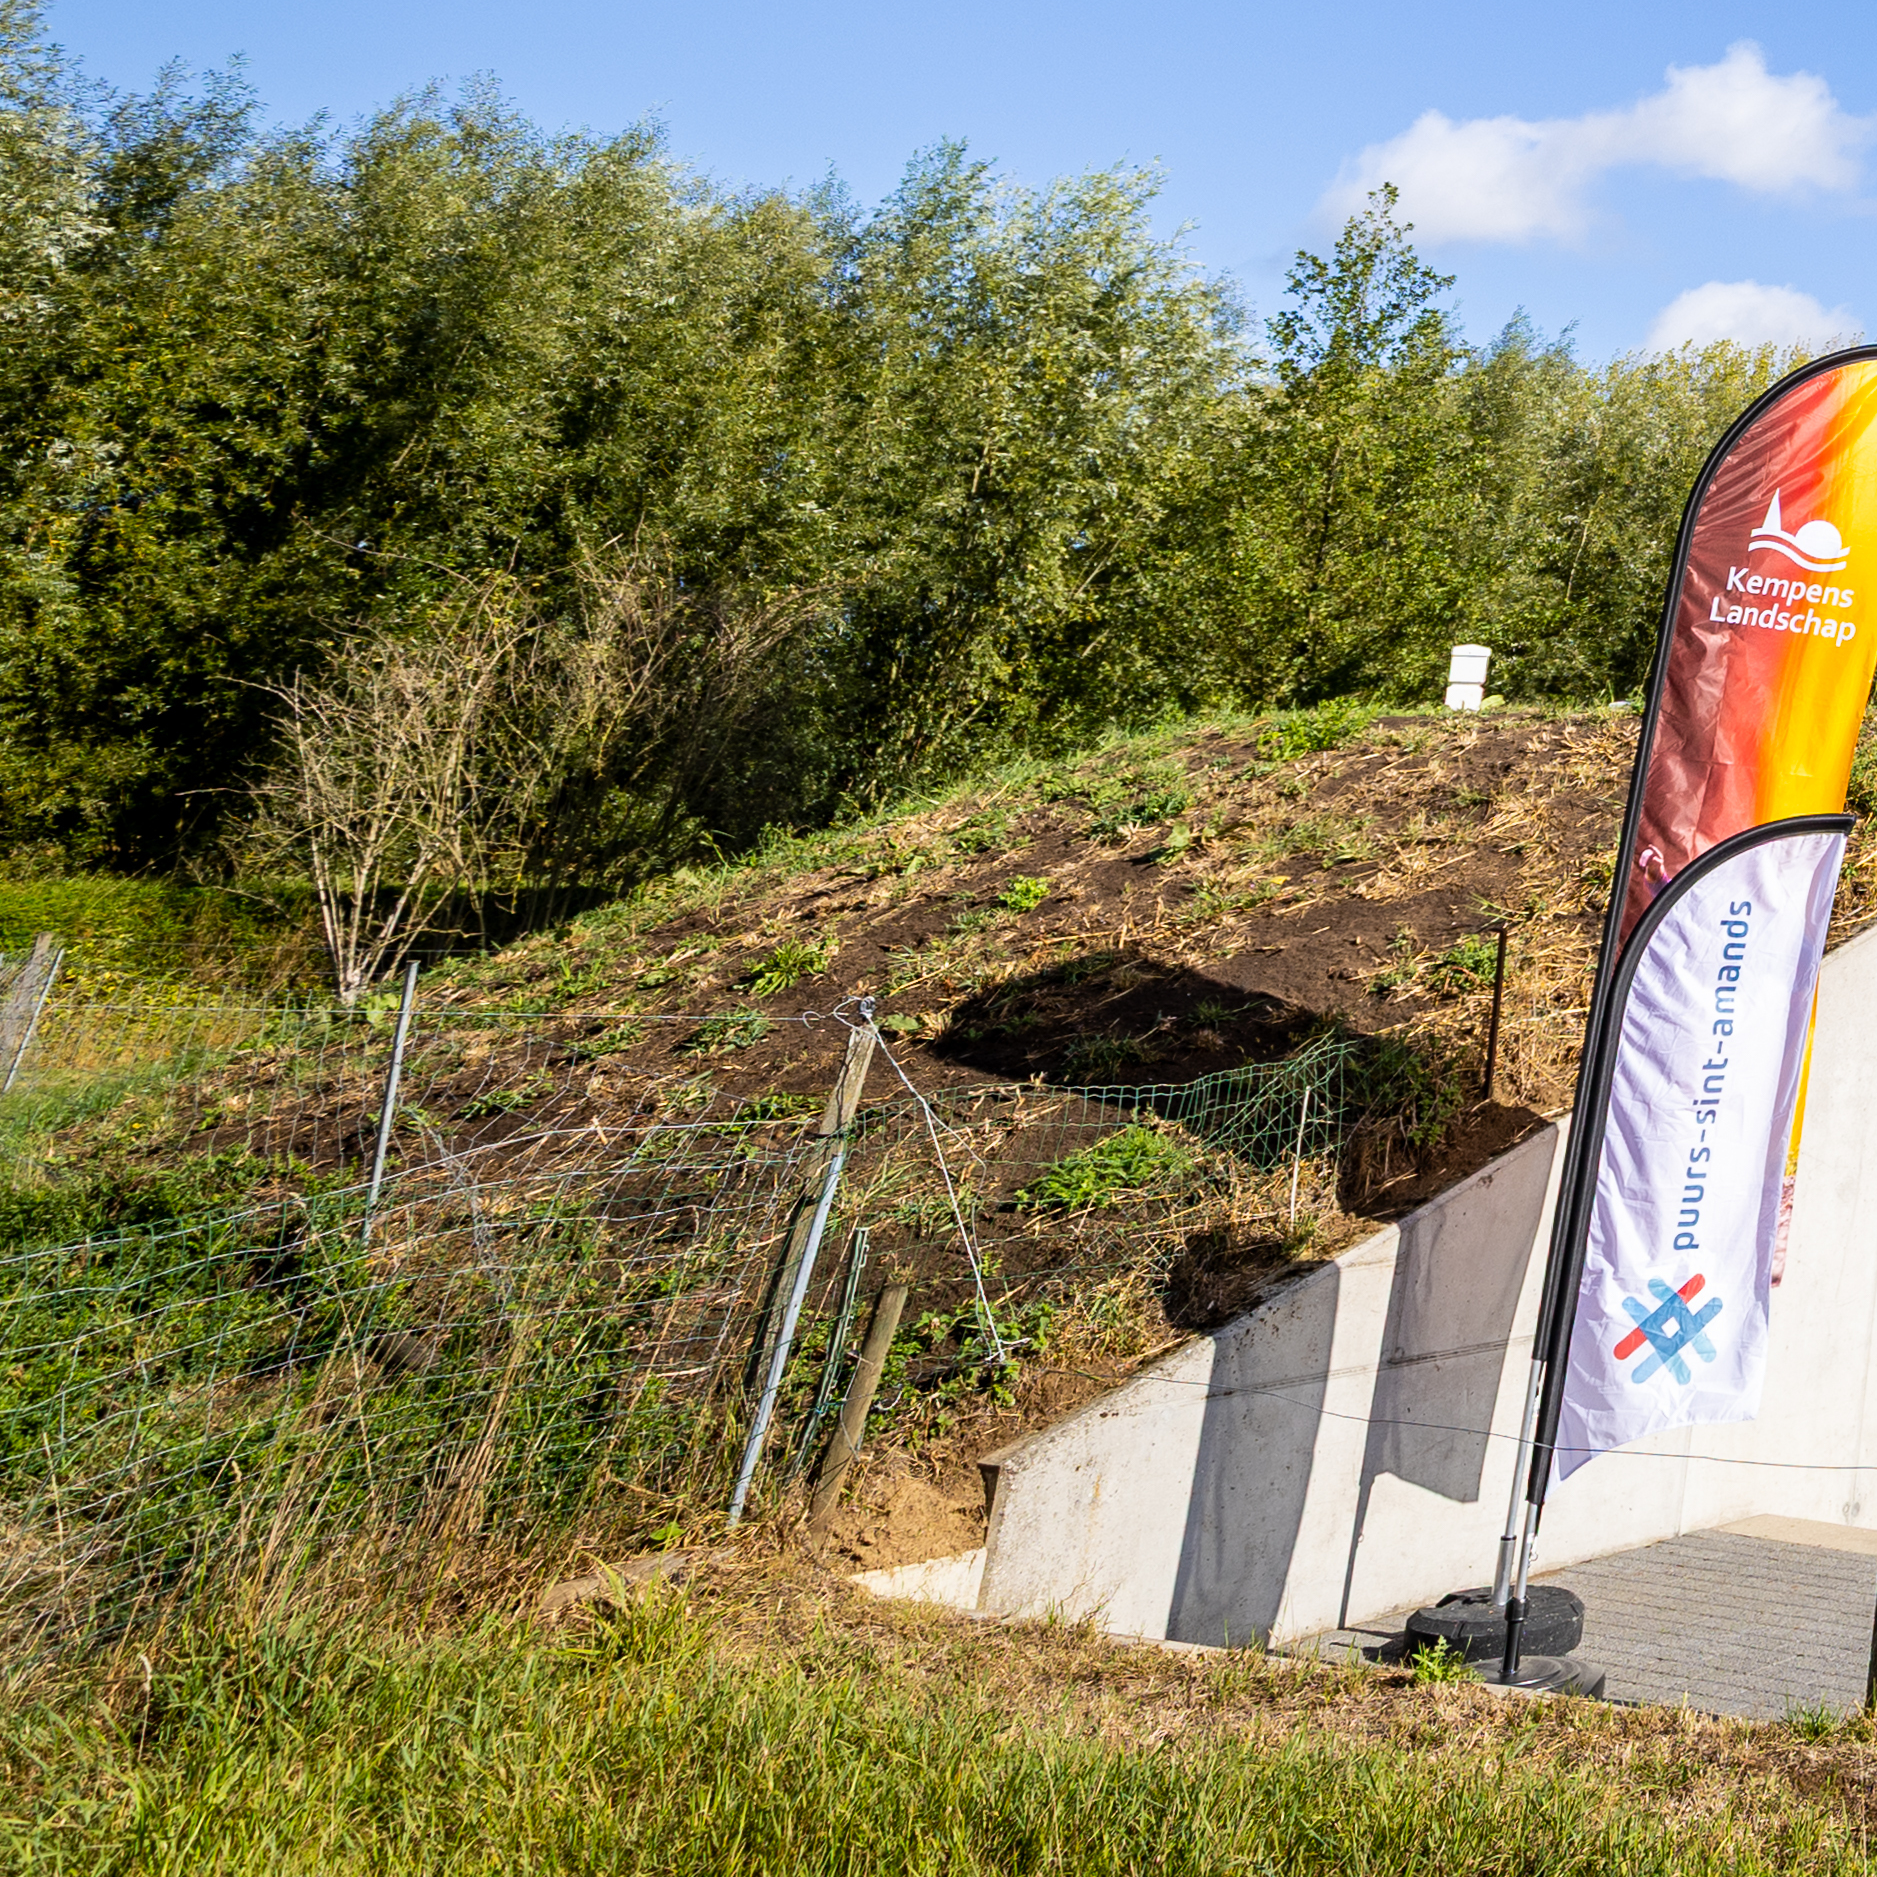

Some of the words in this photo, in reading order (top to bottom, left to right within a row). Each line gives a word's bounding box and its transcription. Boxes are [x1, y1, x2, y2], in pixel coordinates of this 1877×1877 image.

[1726, 566, 1855, 608] Kempens
[1709, 596, 1856, 648] Landschap
[1673, 900, 1752, 1251] puurs-sint-amands
